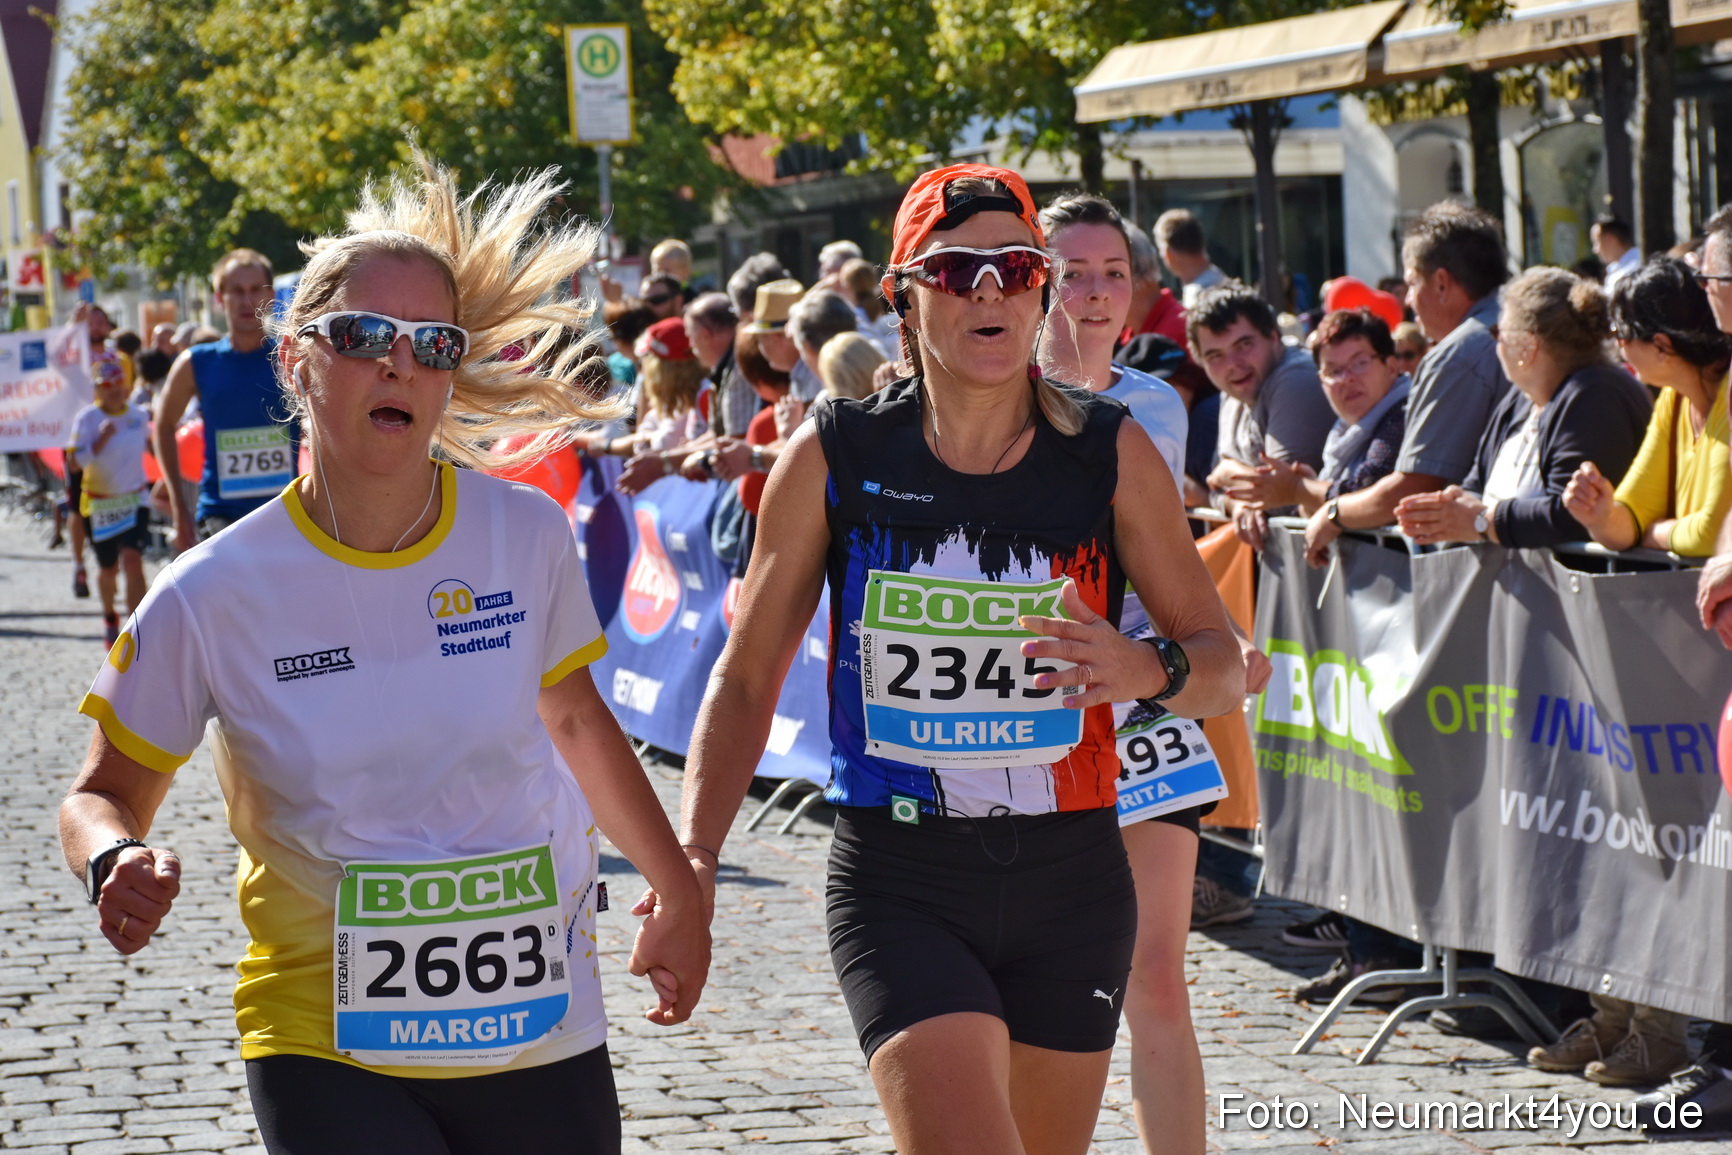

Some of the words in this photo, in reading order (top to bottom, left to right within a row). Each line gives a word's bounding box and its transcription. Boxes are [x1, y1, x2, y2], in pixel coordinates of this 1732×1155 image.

[0, 377, 63, 399] REICH
[227, 450, 284, 475] 2769
[432, 587, 473, 618] 20
[478, 593, 510, 610] JAHRE
[879, 580, 1062, 632] BOCK
[436, 609, 527, 637] Neumarkter
[440, 631, 512, 657] Stadtlauf
[273, 646, 354, 676] BOCK
[886, 644, 1057, 701] 2345
[910, 720, 1035, 746] ULRIKE
[1118, 781, 1175, 811] RITA
[356, 855, 546, 918] BOCK
[366, 925, 546, 998] 2663
[548, 925, 555, 937] D
[389, 1010, 529, 1044] MARGIT
